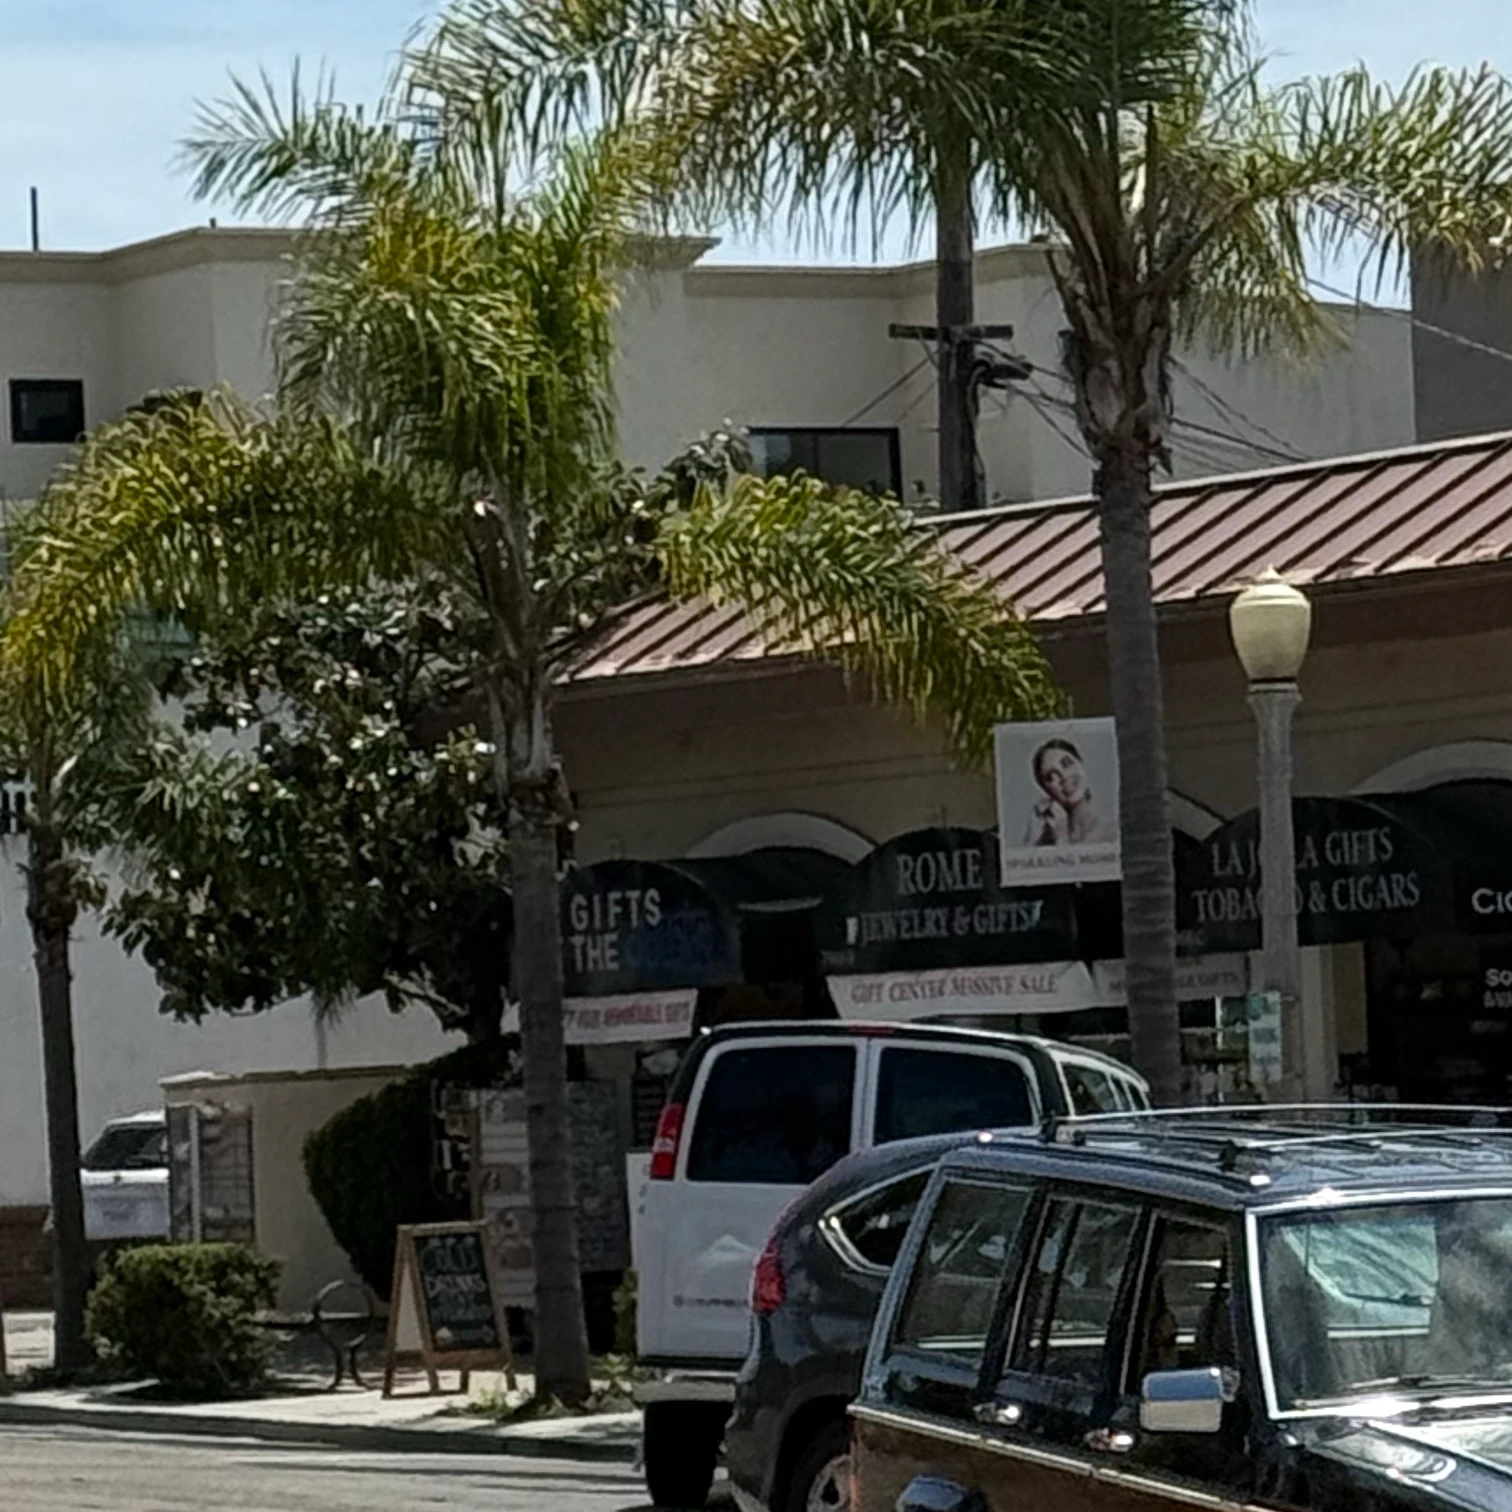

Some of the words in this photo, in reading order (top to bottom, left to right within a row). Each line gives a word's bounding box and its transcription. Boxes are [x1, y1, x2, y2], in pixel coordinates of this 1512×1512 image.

[896, 848, 984, 896] ROME
[1212, 840, 1244, 878] LA
[1325, 826, 1394, 867] GIFTS
[569, 887, 662, 932] GIFTS
[1309, 880, 1327, 914] &
[1332, 872, 1420, 912] CIGARS
[860, 907, 950, 948] JEWELRY
[952, 904, 972, 937] &
[569, 932, 620, 973] THE
[1018, 973, 1058, 994] SALE
